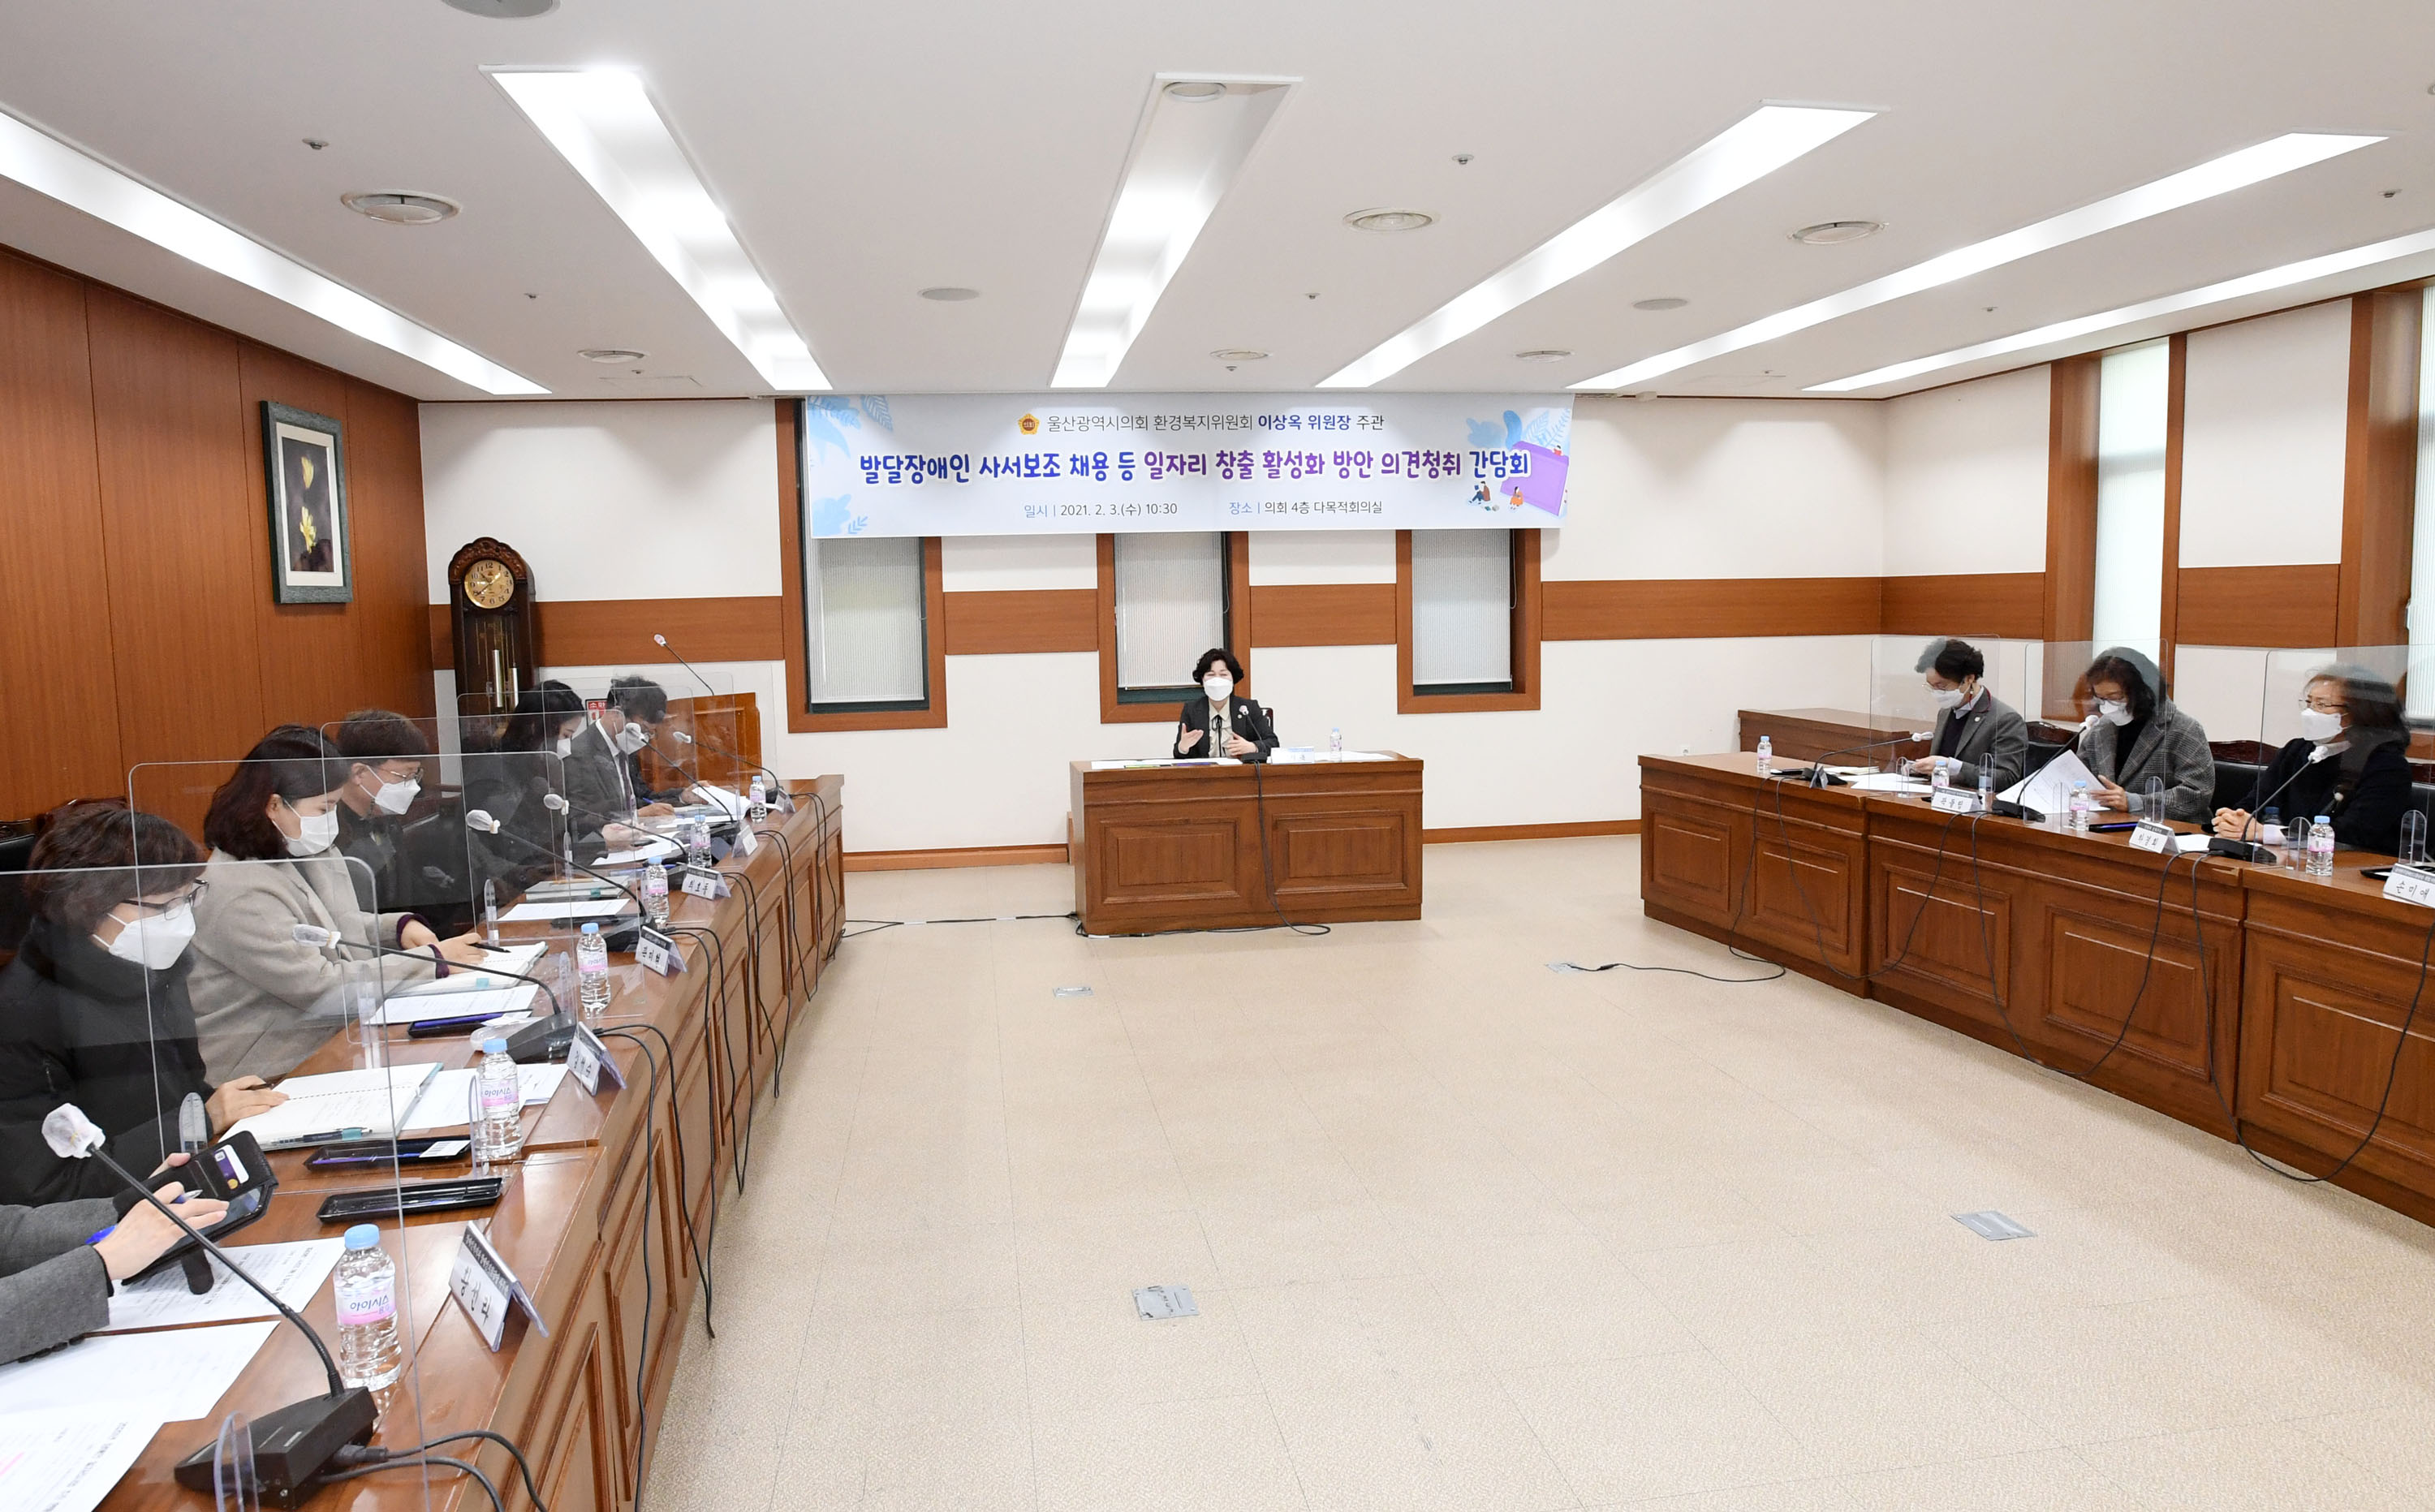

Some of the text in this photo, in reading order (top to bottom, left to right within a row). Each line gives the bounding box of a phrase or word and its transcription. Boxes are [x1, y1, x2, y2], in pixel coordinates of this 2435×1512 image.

[1047, 415, 1385, 433] 울산광역시의회 환경복지위원회 이상옥 위원장 주관
[860, 449, 1530, 485] 발달장애인 사서보조 채용 등 일자리 창출 활성화 방안 의견청취 간담회
[1024, 502, 1178, 519] 일시 2021. 2. 3.(수) 10:30
[1229, 501, 1382, 515] 장소 의회 4층 다목적회의실
[350, 1294, 390, 1312] 아이시스
